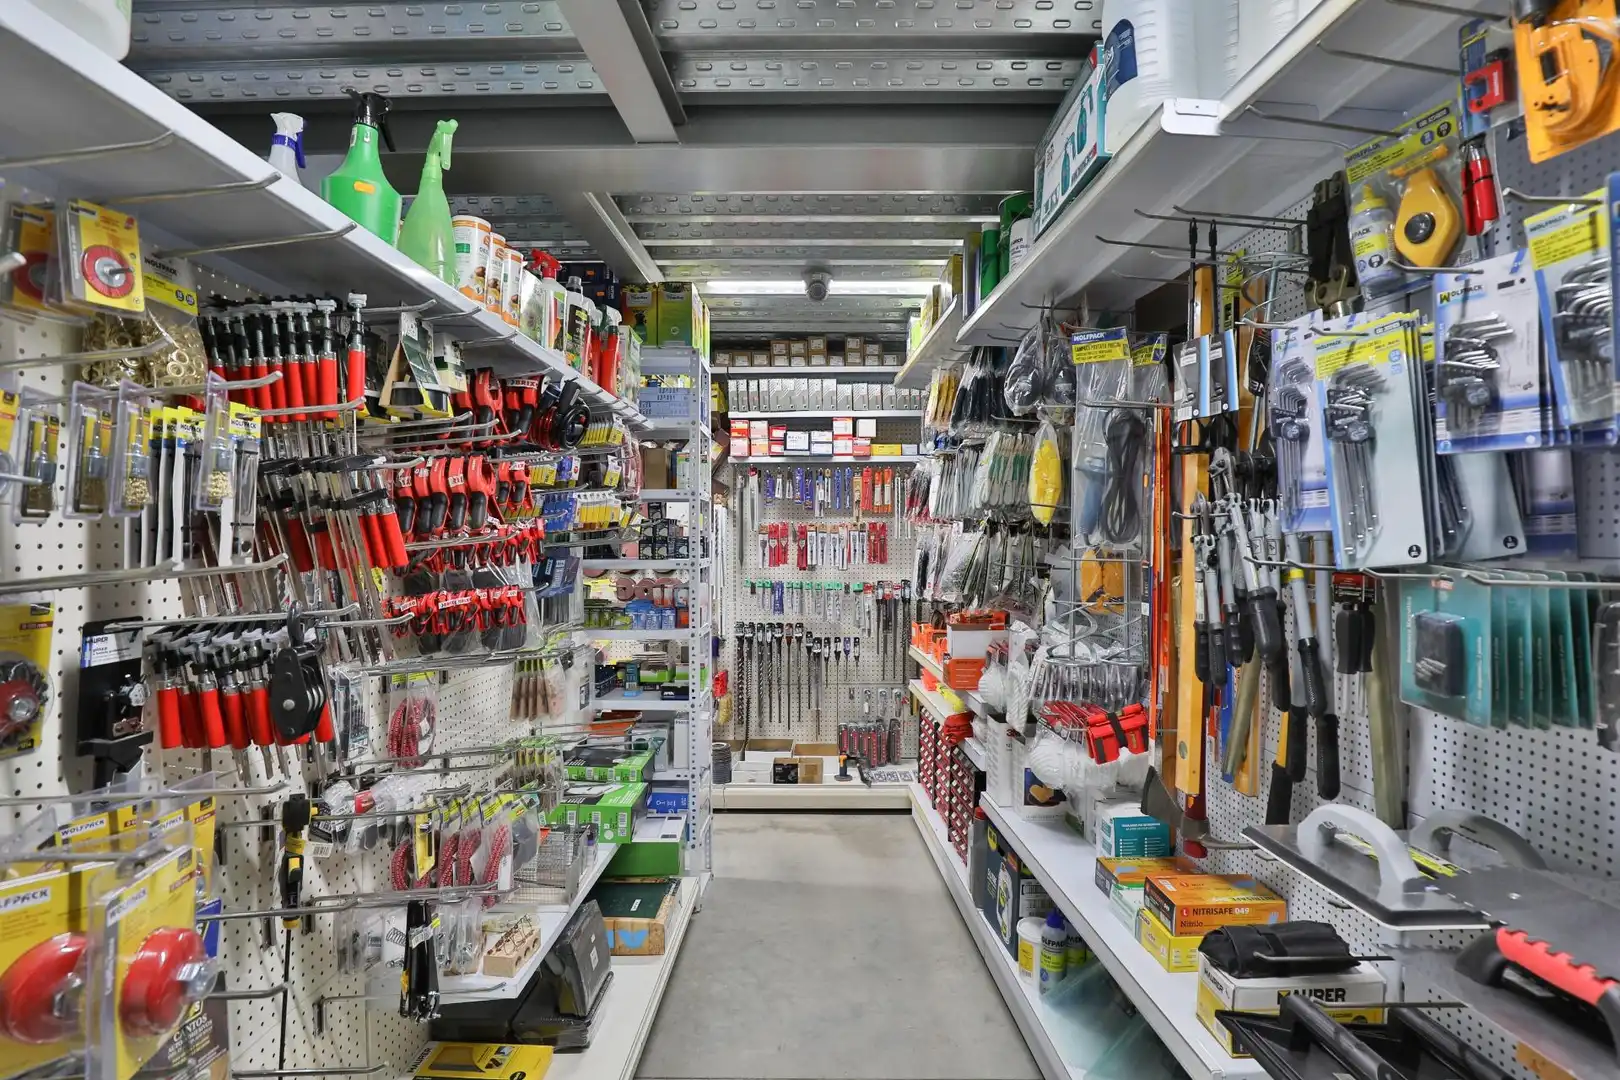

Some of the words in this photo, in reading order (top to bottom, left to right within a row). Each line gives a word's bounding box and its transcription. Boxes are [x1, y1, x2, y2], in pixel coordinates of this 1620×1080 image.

[1073, 332, 1105, 342] WOLFPACK
[61, 818, 105, 836] WOLFPACK
[0, 888, 48, 908] FPACK
[1192, 907, 1233, 916] NITRISAFE
[1234, 907, 1250, 915] 049
[406, 1047, 432, 1073] MAURER
